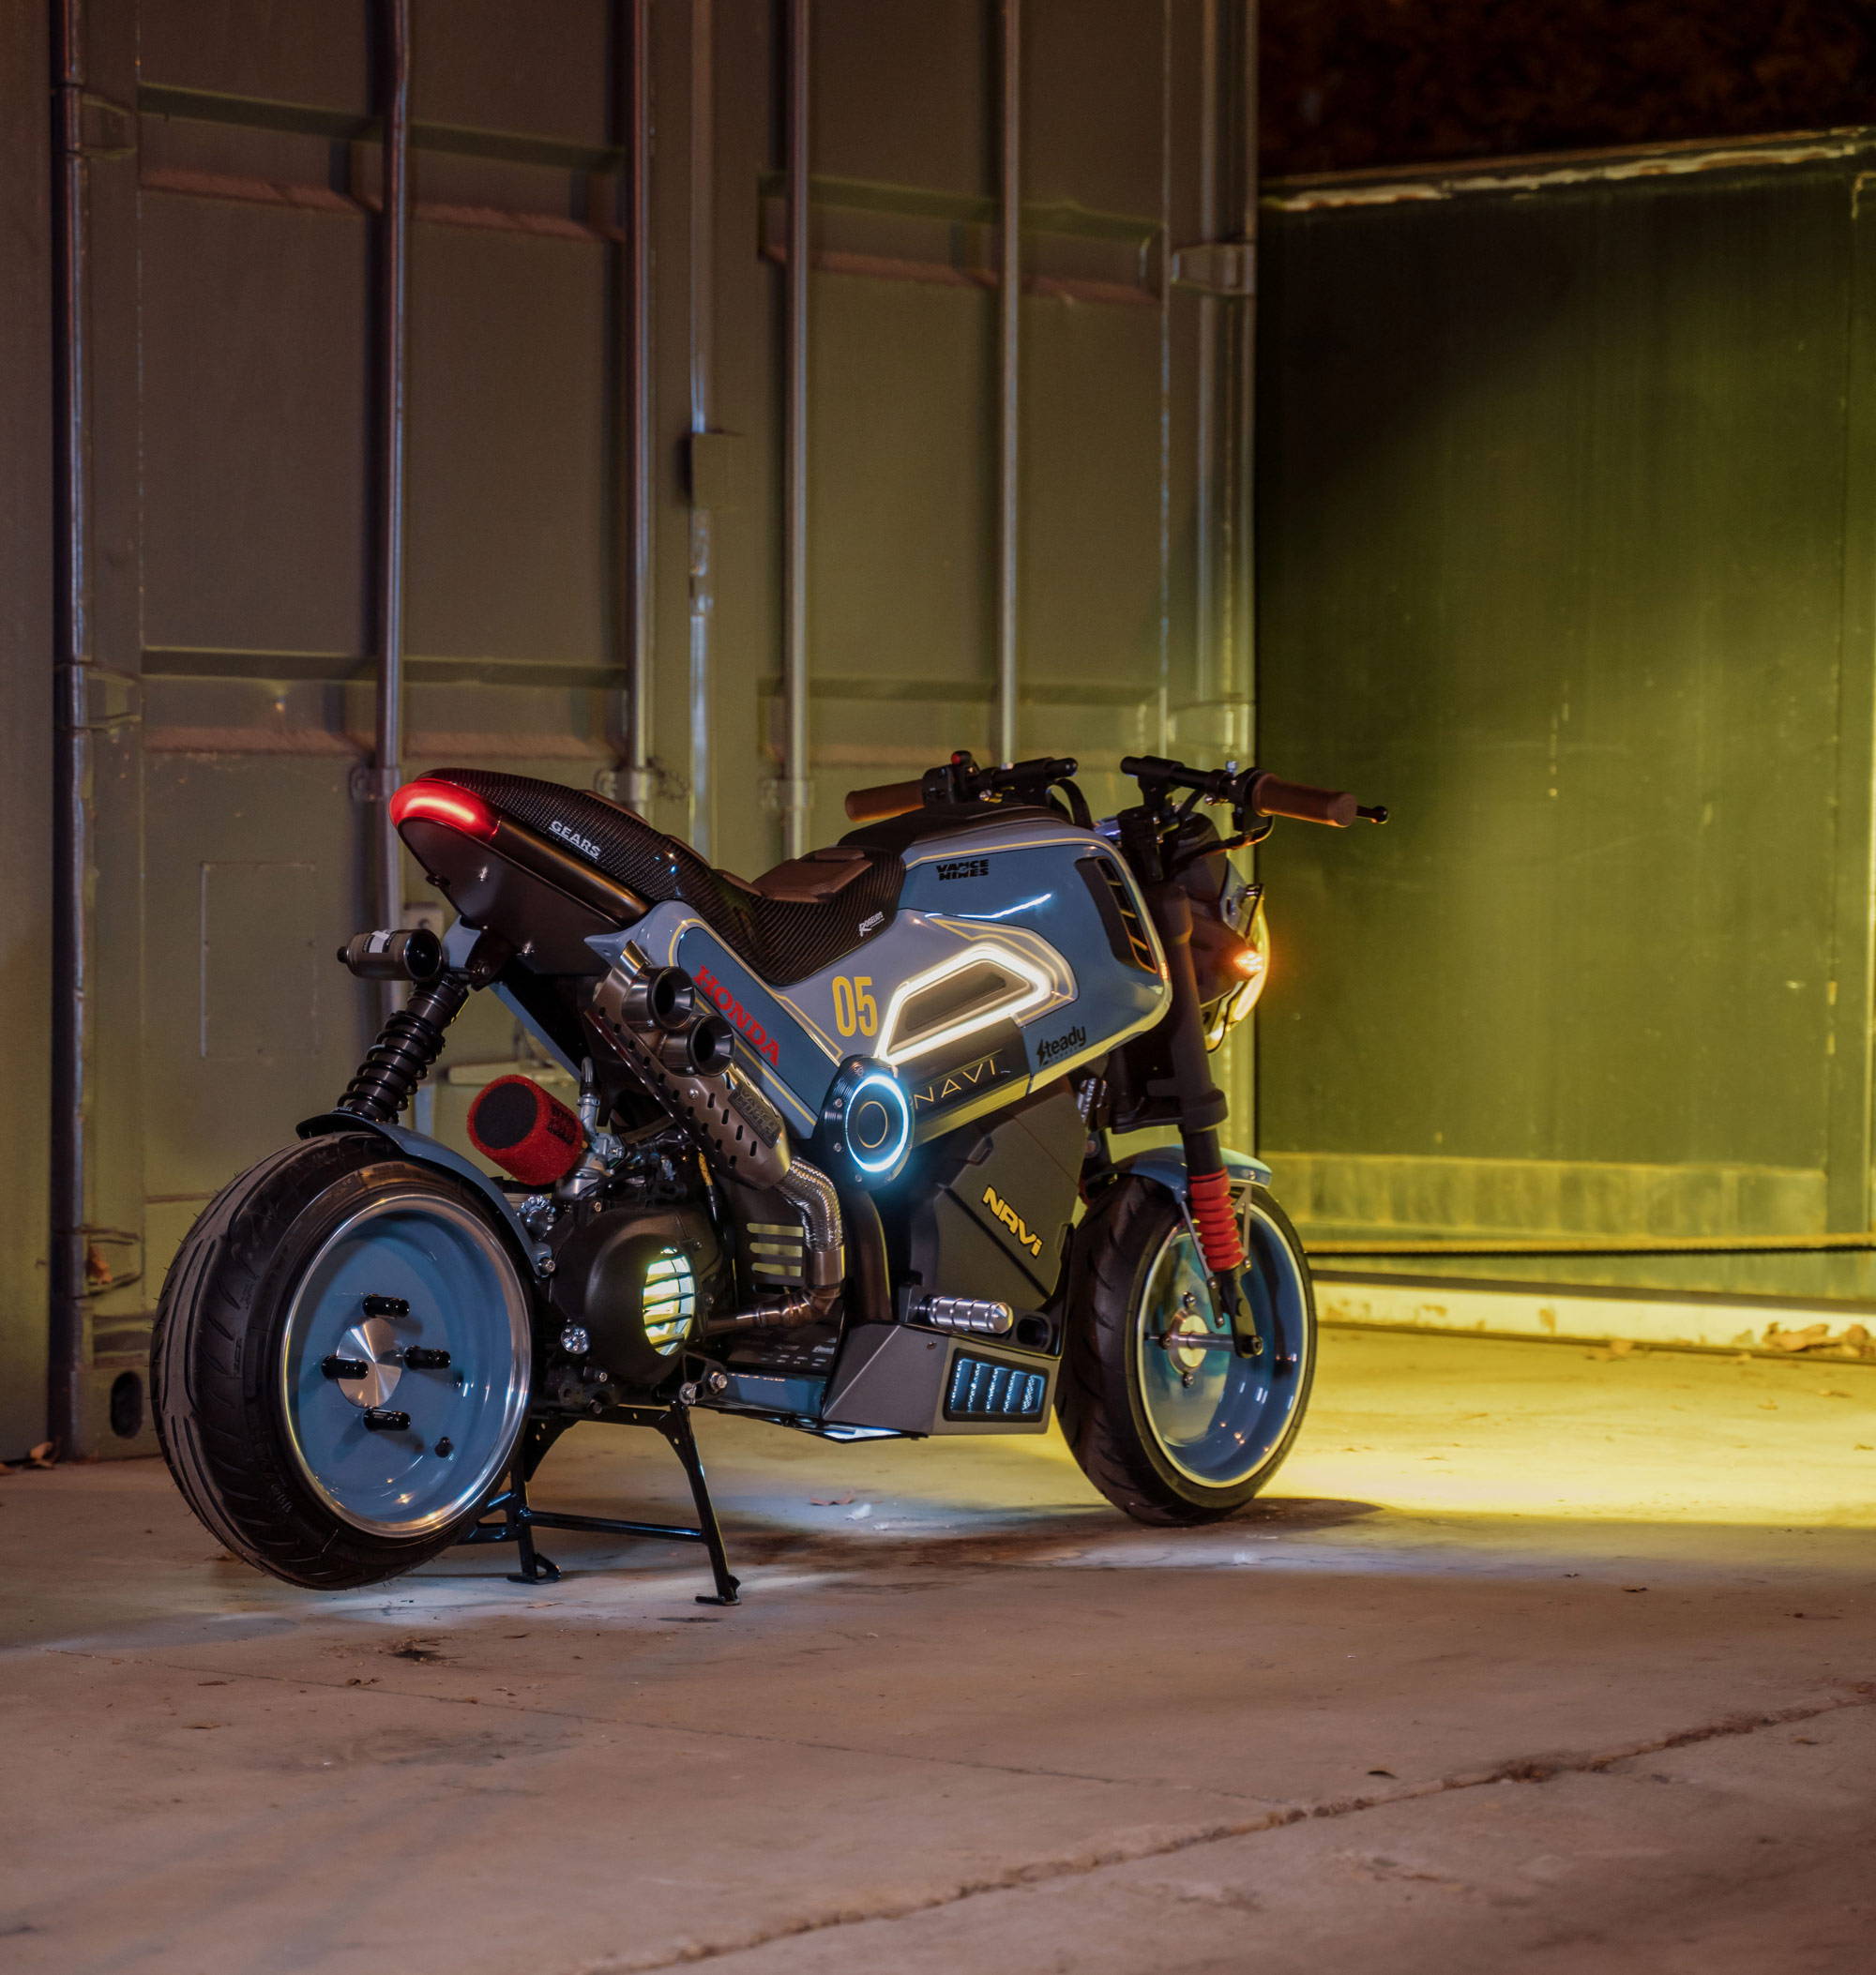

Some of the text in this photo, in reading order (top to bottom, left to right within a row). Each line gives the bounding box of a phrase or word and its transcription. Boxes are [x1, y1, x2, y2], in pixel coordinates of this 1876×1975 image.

[549, 820, 601, 860] GEARS
[936, 859, 991, 872] VANCE
[692, 964, 780, 1066] HONDA
[831, 975, 879, 1037] 05
[913, 1058, 996, 1110] NAVI
